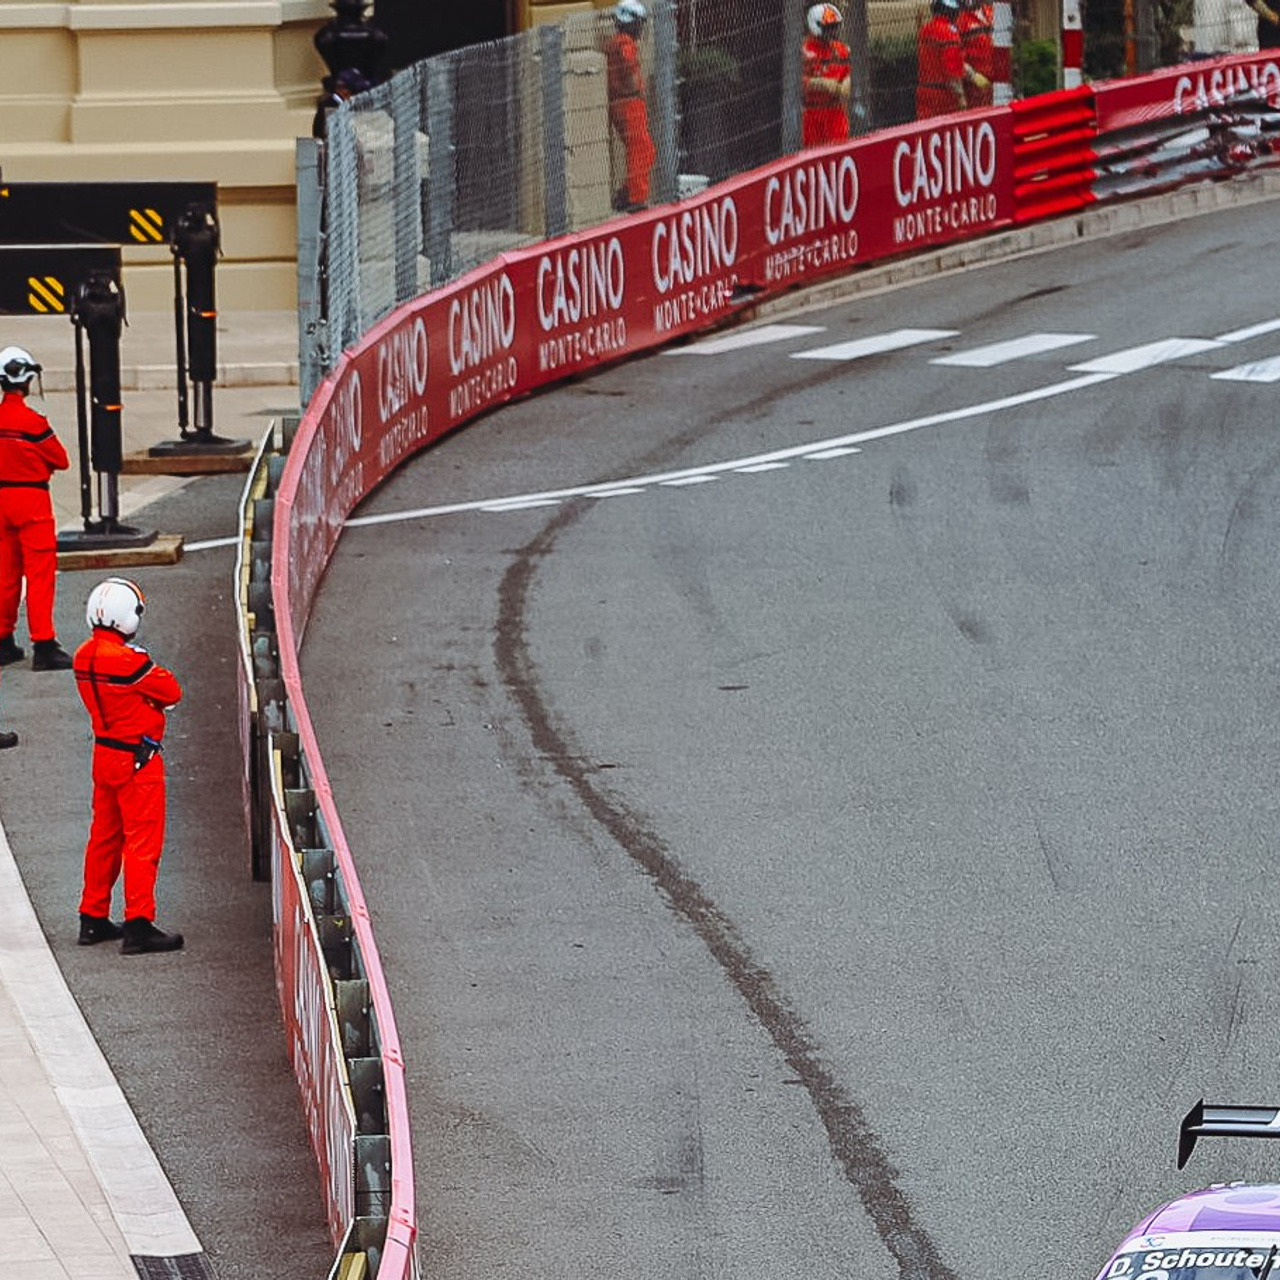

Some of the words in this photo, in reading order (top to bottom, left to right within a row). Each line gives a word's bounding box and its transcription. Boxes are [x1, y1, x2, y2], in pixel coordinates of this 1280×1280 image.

[765, 155, 859, 245] CASINO
[893, 121, 996, 207] CASINO
[537, 237, 625, 331] CASINO
[652, 197, 738, 293] CASINO
[449, 273, 515, 376] CASINO
[1106, 1257, 1134, 1278] D.
